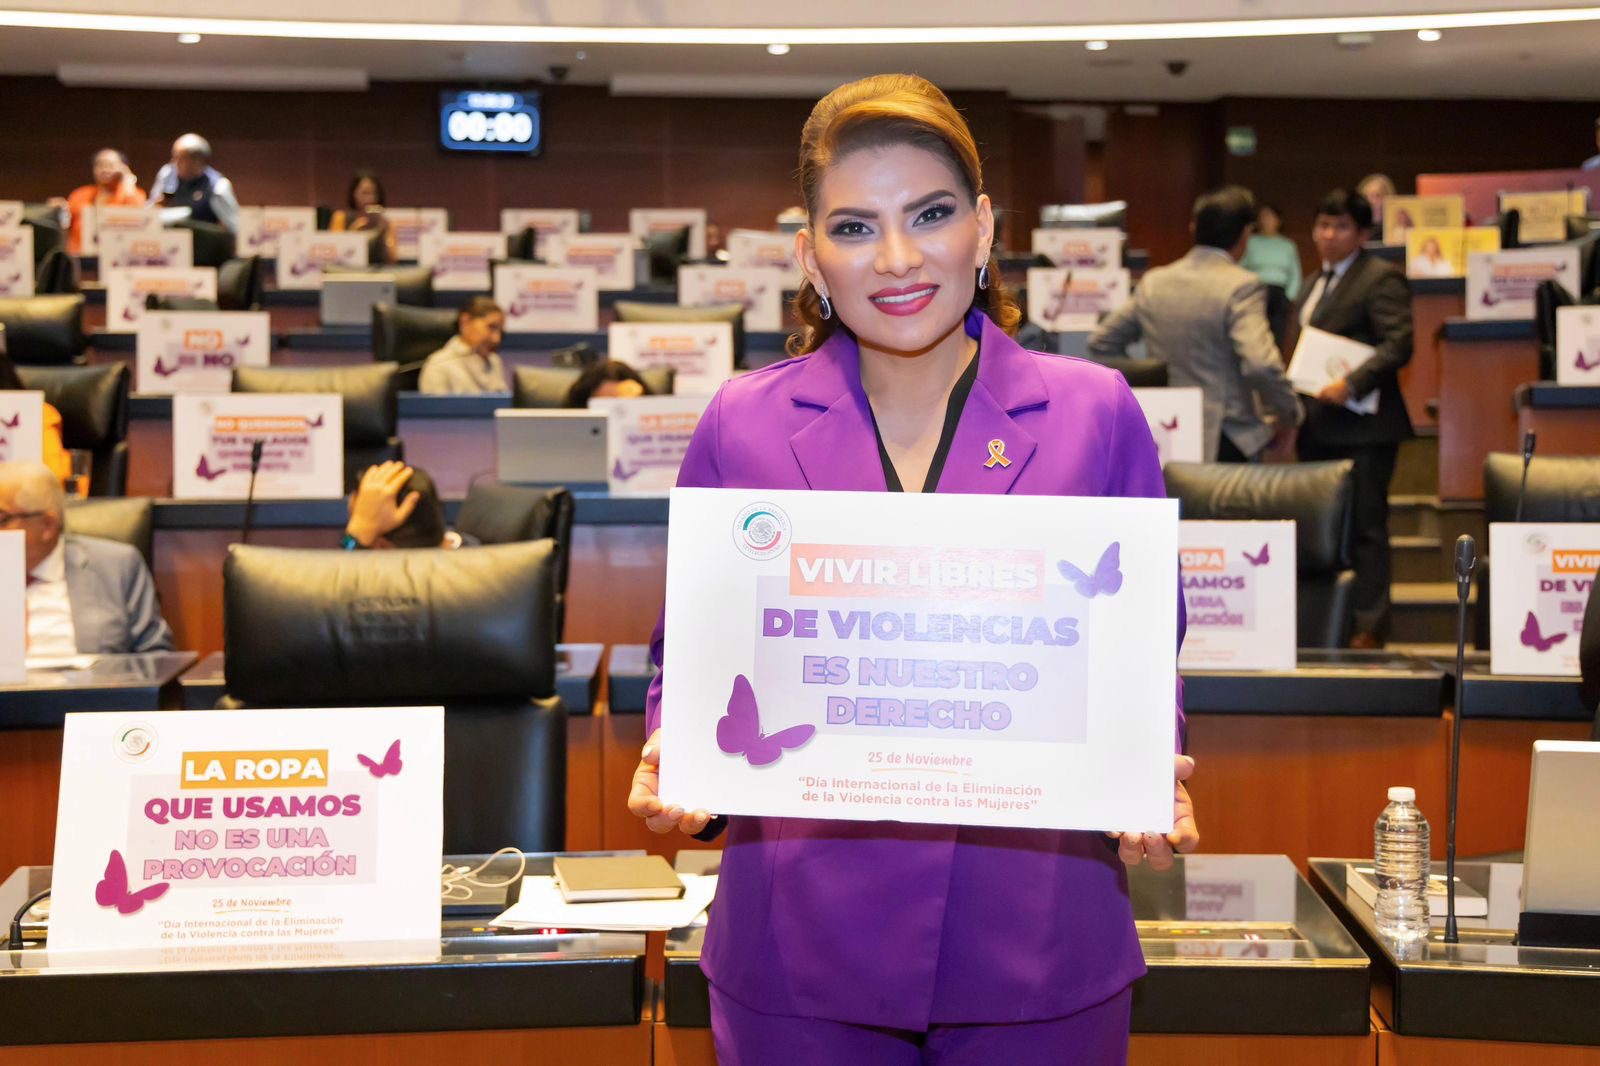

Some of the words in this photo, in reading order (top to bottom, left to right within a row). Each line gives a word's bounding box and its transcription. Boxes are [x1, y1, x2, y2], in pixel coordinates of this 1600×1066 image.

[448, 110, 533, 143] 00:00
[1180, 553, 1223, 567] OPA
[797, 557, 898, 586] VIVIR
[909, 557, 1039, 589] LIBRES
[1540, 580, 1567, 592] DE
[762, 608, 819, 638] DE
[827, 609, 1080, 647] VIOLENCIAS
[802, 655, 851, 686] ES
[858, 657, 1039, 691] NUESTRO
[826, 696, 1013, 731] DERECHO
[185, 759, 227, 781] LA
[235, 758, 326, 781] ROPA
[868, 751, 883, 763] 25
[887, 752, 902, 764] de
[905, 752, 973, 767] Noviembre
[832, 777, 921, 792] Internacional
[925, 781, 942, 792] de
[946, 782, 958, 793] la
[962, 783, 1042, 796] Eliminación
[144, 797, 214, 825] QUE
[222, 794, 362, 819] USAMOS
[801, 791, 819, 802] de
[823, 791, 835, 802] la
[839, 792, 902, 805] Violencia
[906, 796, 950, 807] contra
[954, 797, 973, 808] las
[174, 829, 219, 850] NO
[225, 828, 261, 850] ES
[266, 827, 330, 848] UNA
[143, 850, 357, 880] PROVOCACIÓN
[212, 898, 224, 908] 25
[226, 898, 237, 907] de
[241, 896, 292, 907] Noviembre
[184, 919, 252, 928] Internacional
[255, 918, 269, 926] de
[271, 918, 280, 926] la
[284, 915, 343, 926] Eliminación
[160, 931, 173, 940] de
[177, 931, 186, 939] la
[190, 929, 238, 939] Violencia
[241, 928, 274, 937] contra
[277, 928, 291, 937] las
